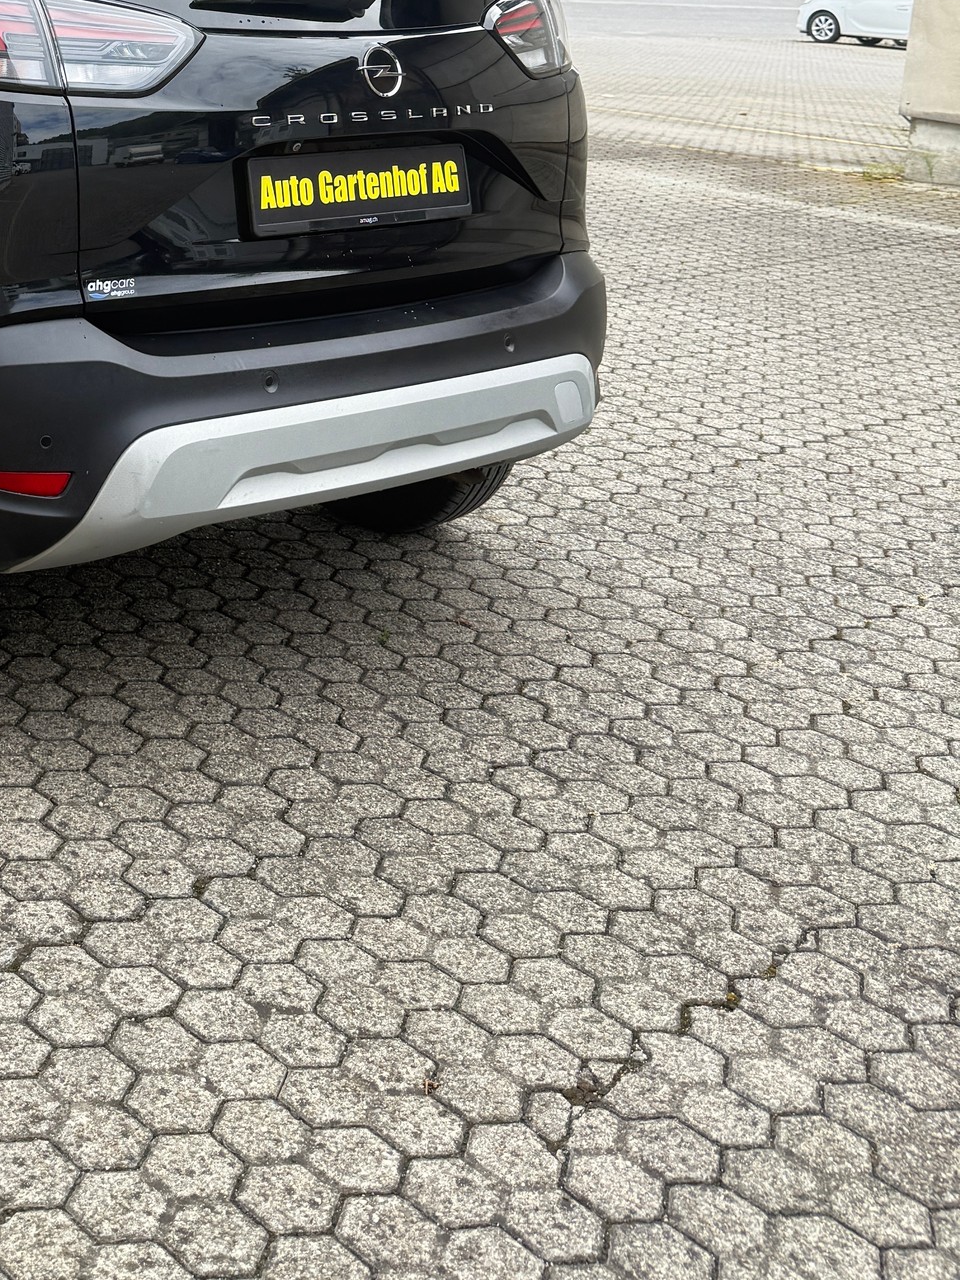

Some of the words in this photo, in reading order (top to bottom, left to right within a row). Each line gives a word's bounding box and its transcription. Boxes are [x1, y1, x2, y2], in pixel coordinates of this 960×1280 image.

[252, 103, 494, 127] CROSSLAND
[260, 175, 315, 210] Auto
[318, 163, 428, 204] Gartenhof
[432, 160, 460, 194] AG
